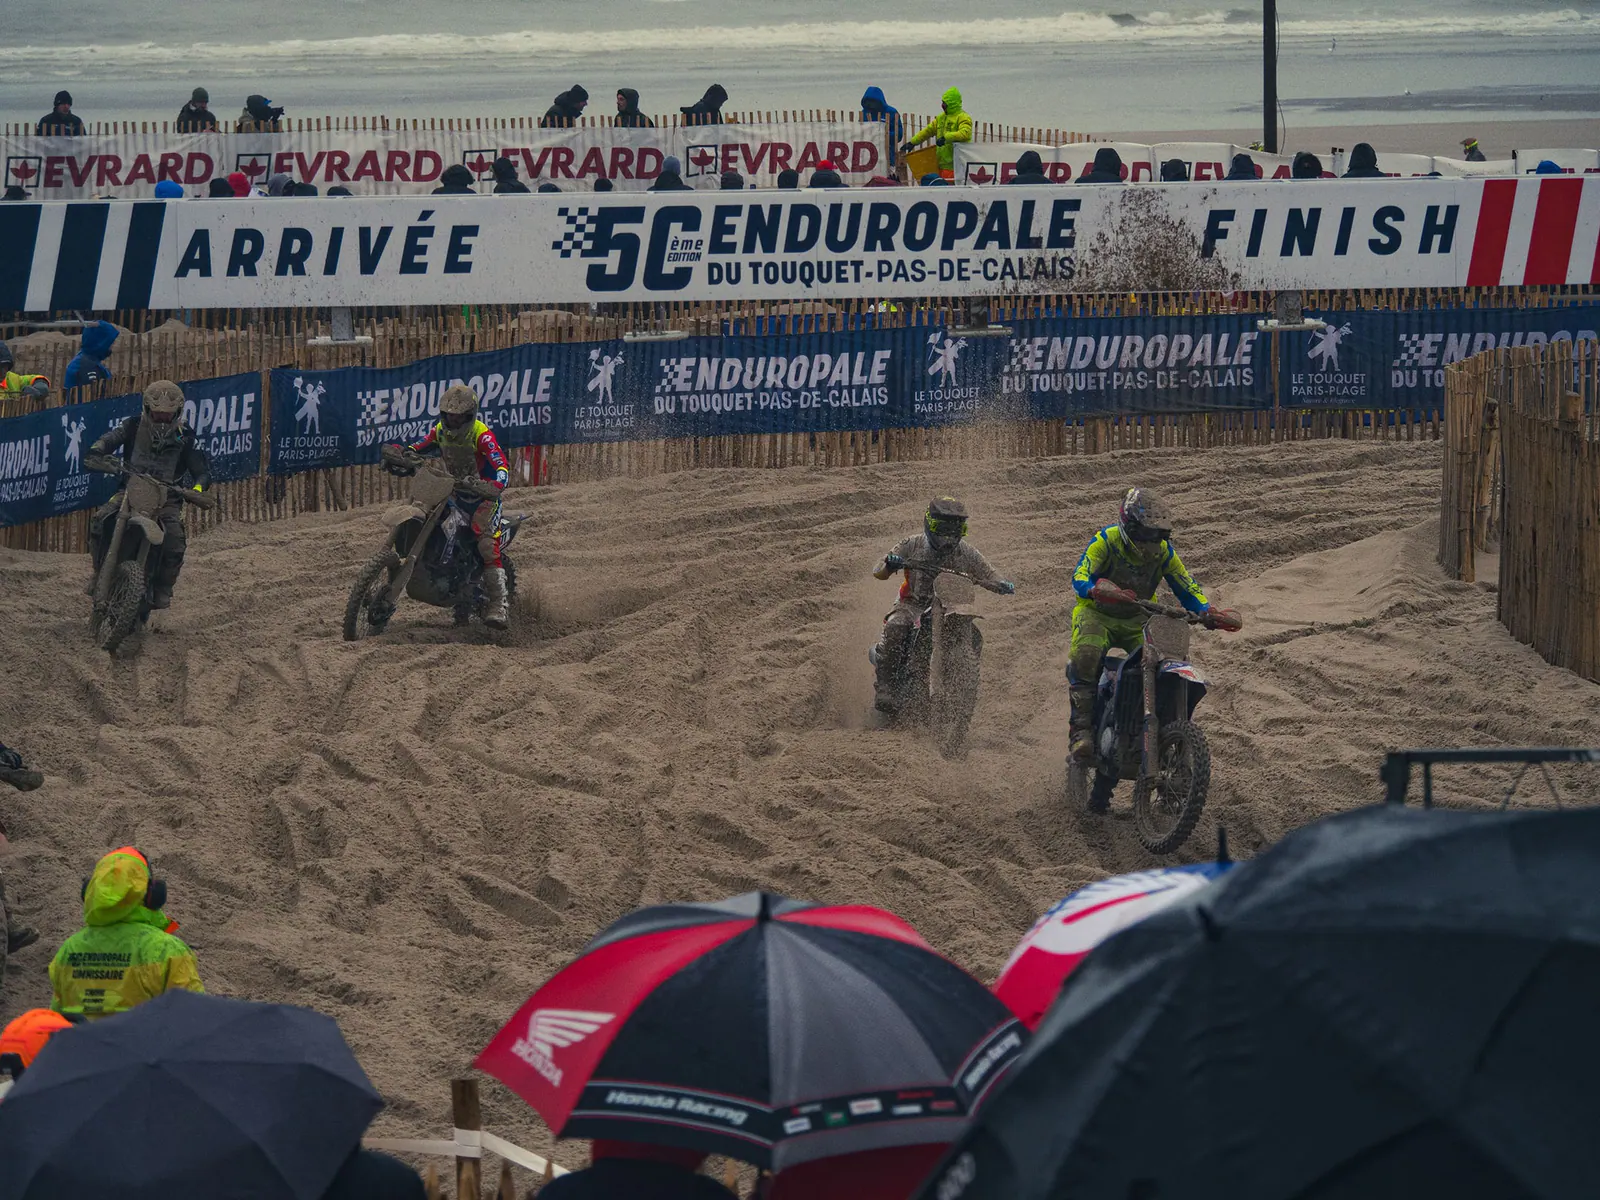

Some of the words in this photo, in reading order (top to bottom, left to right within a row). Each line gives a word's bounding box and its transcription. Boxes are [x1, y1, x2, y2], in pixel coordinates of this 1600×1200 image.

[274, 149, 443, 184] EVRARD
[720, 141, 879, 175] EVRARD
[43, 152, 214, 188] EVRARD
[708, 198, 1082, 254] ENDUROPALE
[1201, 204, 1460, 259] FINISH
[174, 209, 480, 278] ARRIVÉE
[670, 235, 704, 251] ème
[667, 251, 702, 262] EDITION
[708, 261, 742, 285] DU
[1024, 331, 1259, 372] ENDUROPALE
[674, 349, 892, 393] ENDUROPALE
[1292, 373, 1304, 384] LE
[1308, 373, 1366, 384] TOUQUET
[1391, 369, 1418, 388] DU
[1002, 373, 1026, 394] DU
[1292, 385, 1366, 396] PARIS-PLAGE
[372, 367, 556, 425] ENDUOPALE
[914, 390, 925, 402] LE
[929, 387, 981, 401] TOUQUET
[574, 407, 586, 418] LE
[588, 404, 635, 417] TOUQUET
[654, 396, 676, 415] DU
[914, 399, 981, 413] PARIS-PLAGE
[574, 417, 635, 430] PARIS-PLAGE
[280, 436, 292, 448] LE
[293, 435, 340, 448] TOUQUET
[356, 428, 376, 448] DU
[62, 473, 91, 489] TOUQUET
[510, 1037, 564, 1088] HONDA
[606, 1089, 676, 1110] Honda
[677, 1097, 749, 1126] Racing
